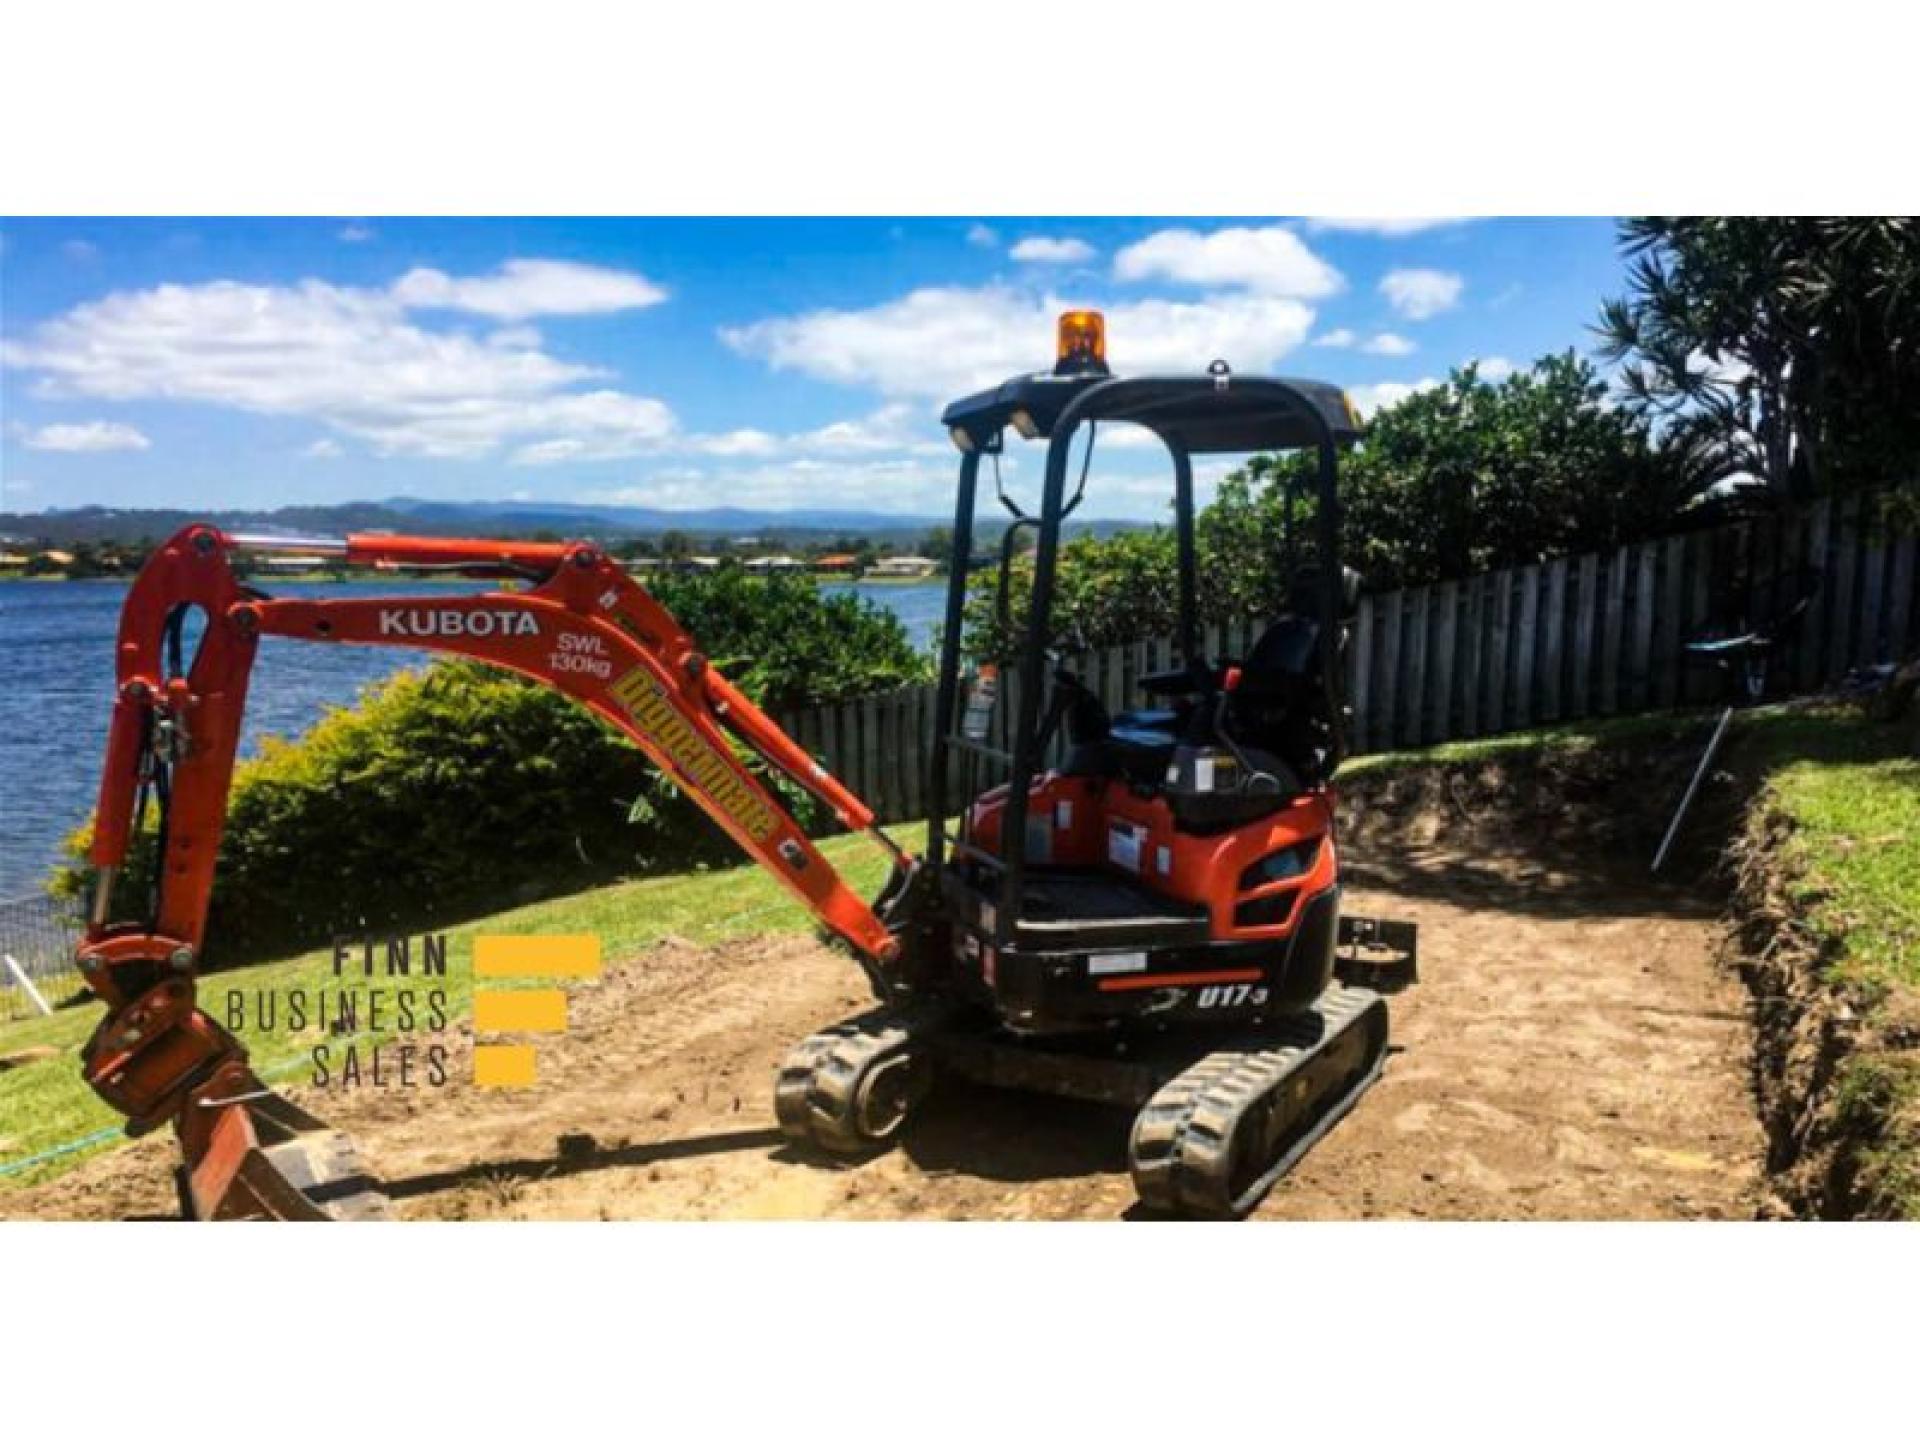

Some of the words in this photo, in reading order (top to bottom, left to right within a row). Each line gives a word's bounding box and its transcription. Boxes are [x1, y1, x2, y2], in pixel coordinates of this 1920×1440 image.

[380, 609, 539, 635] KUBOTA
[557, 633, 609, 655] SWL
[549, 653, 612, 679] 130kg
